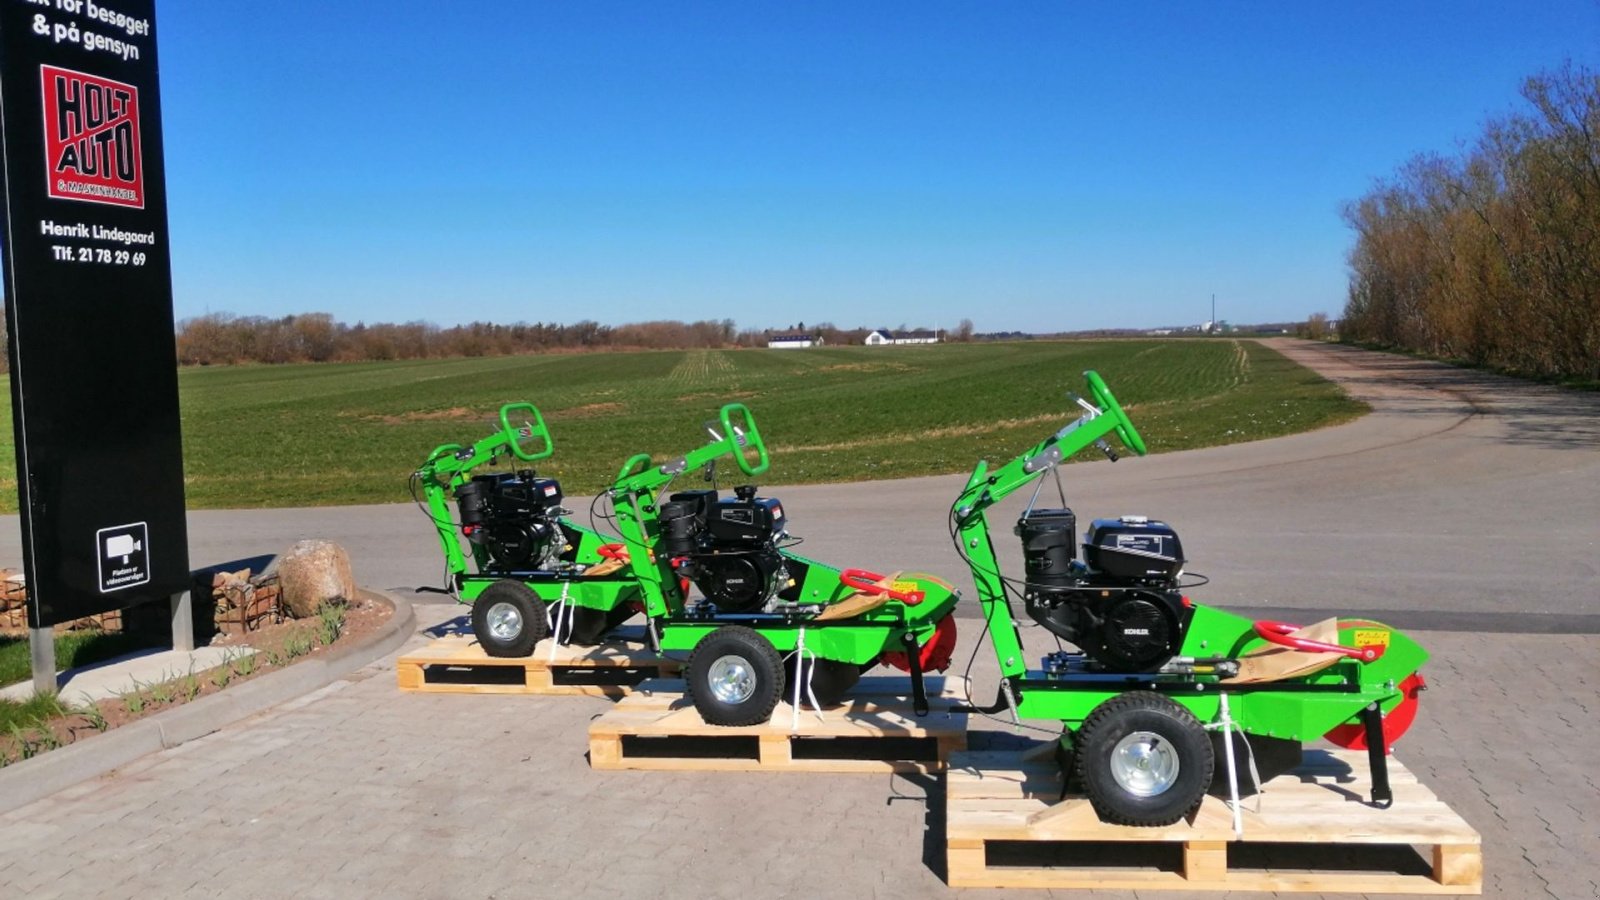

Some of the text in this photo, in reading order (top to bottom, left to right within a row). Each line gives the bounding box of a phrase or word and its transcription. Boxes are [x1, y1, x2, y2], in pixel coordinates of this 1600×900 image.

[87, 0, 150, 36] besøget
[33, 13, 140, 61] & på gensyn
[55, 74, 131, 142] HOLT
[55, 118, 136, 183] AUTO
[57, 178, 68, 193] &
[40, 220, 155, 245] Henrik Lindegaard
[52, 245, 146, 266] Tlf. 21 78 29 69
